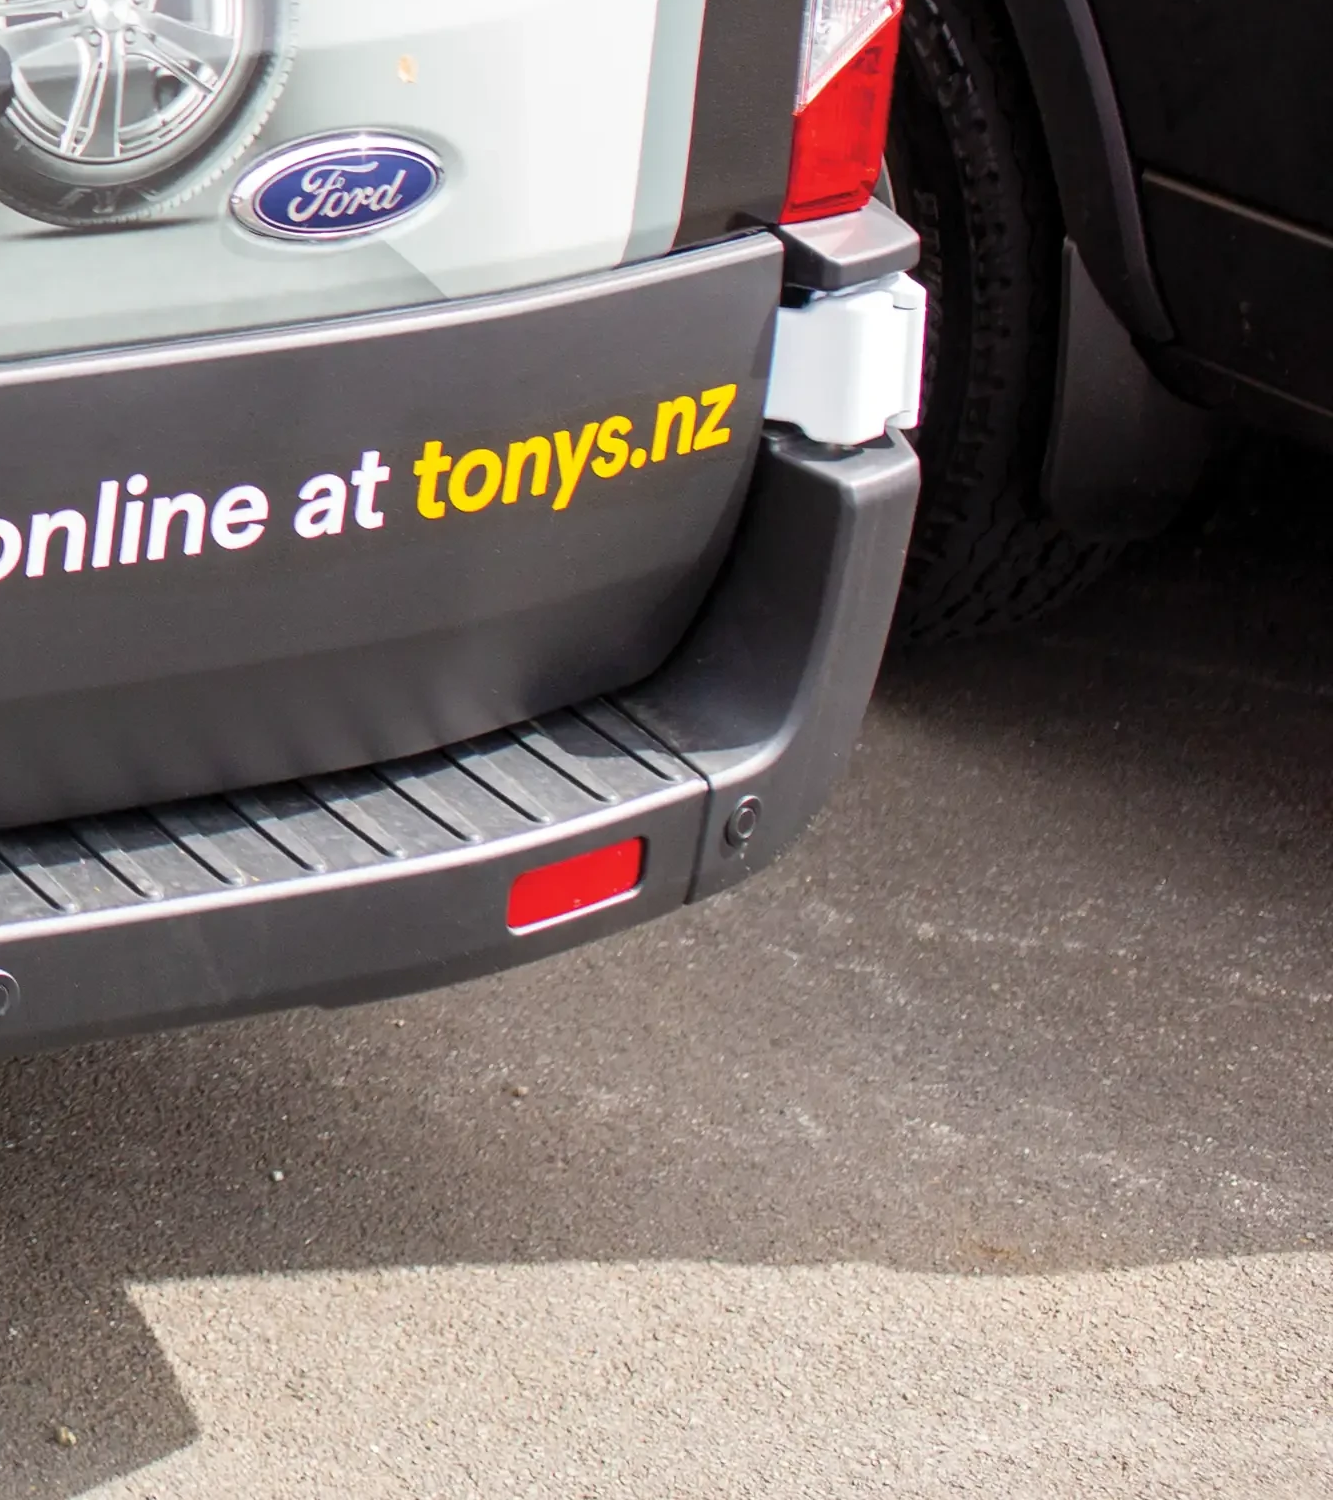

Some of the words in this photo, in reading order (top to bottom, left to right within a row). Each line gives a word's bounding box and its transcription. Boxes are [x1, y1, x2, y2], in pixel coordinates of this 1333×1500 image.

[287, 160, 407, 223] Ford
[293, 450, 391, 539] at
[412, 383, 738, 520] tonys.nz
